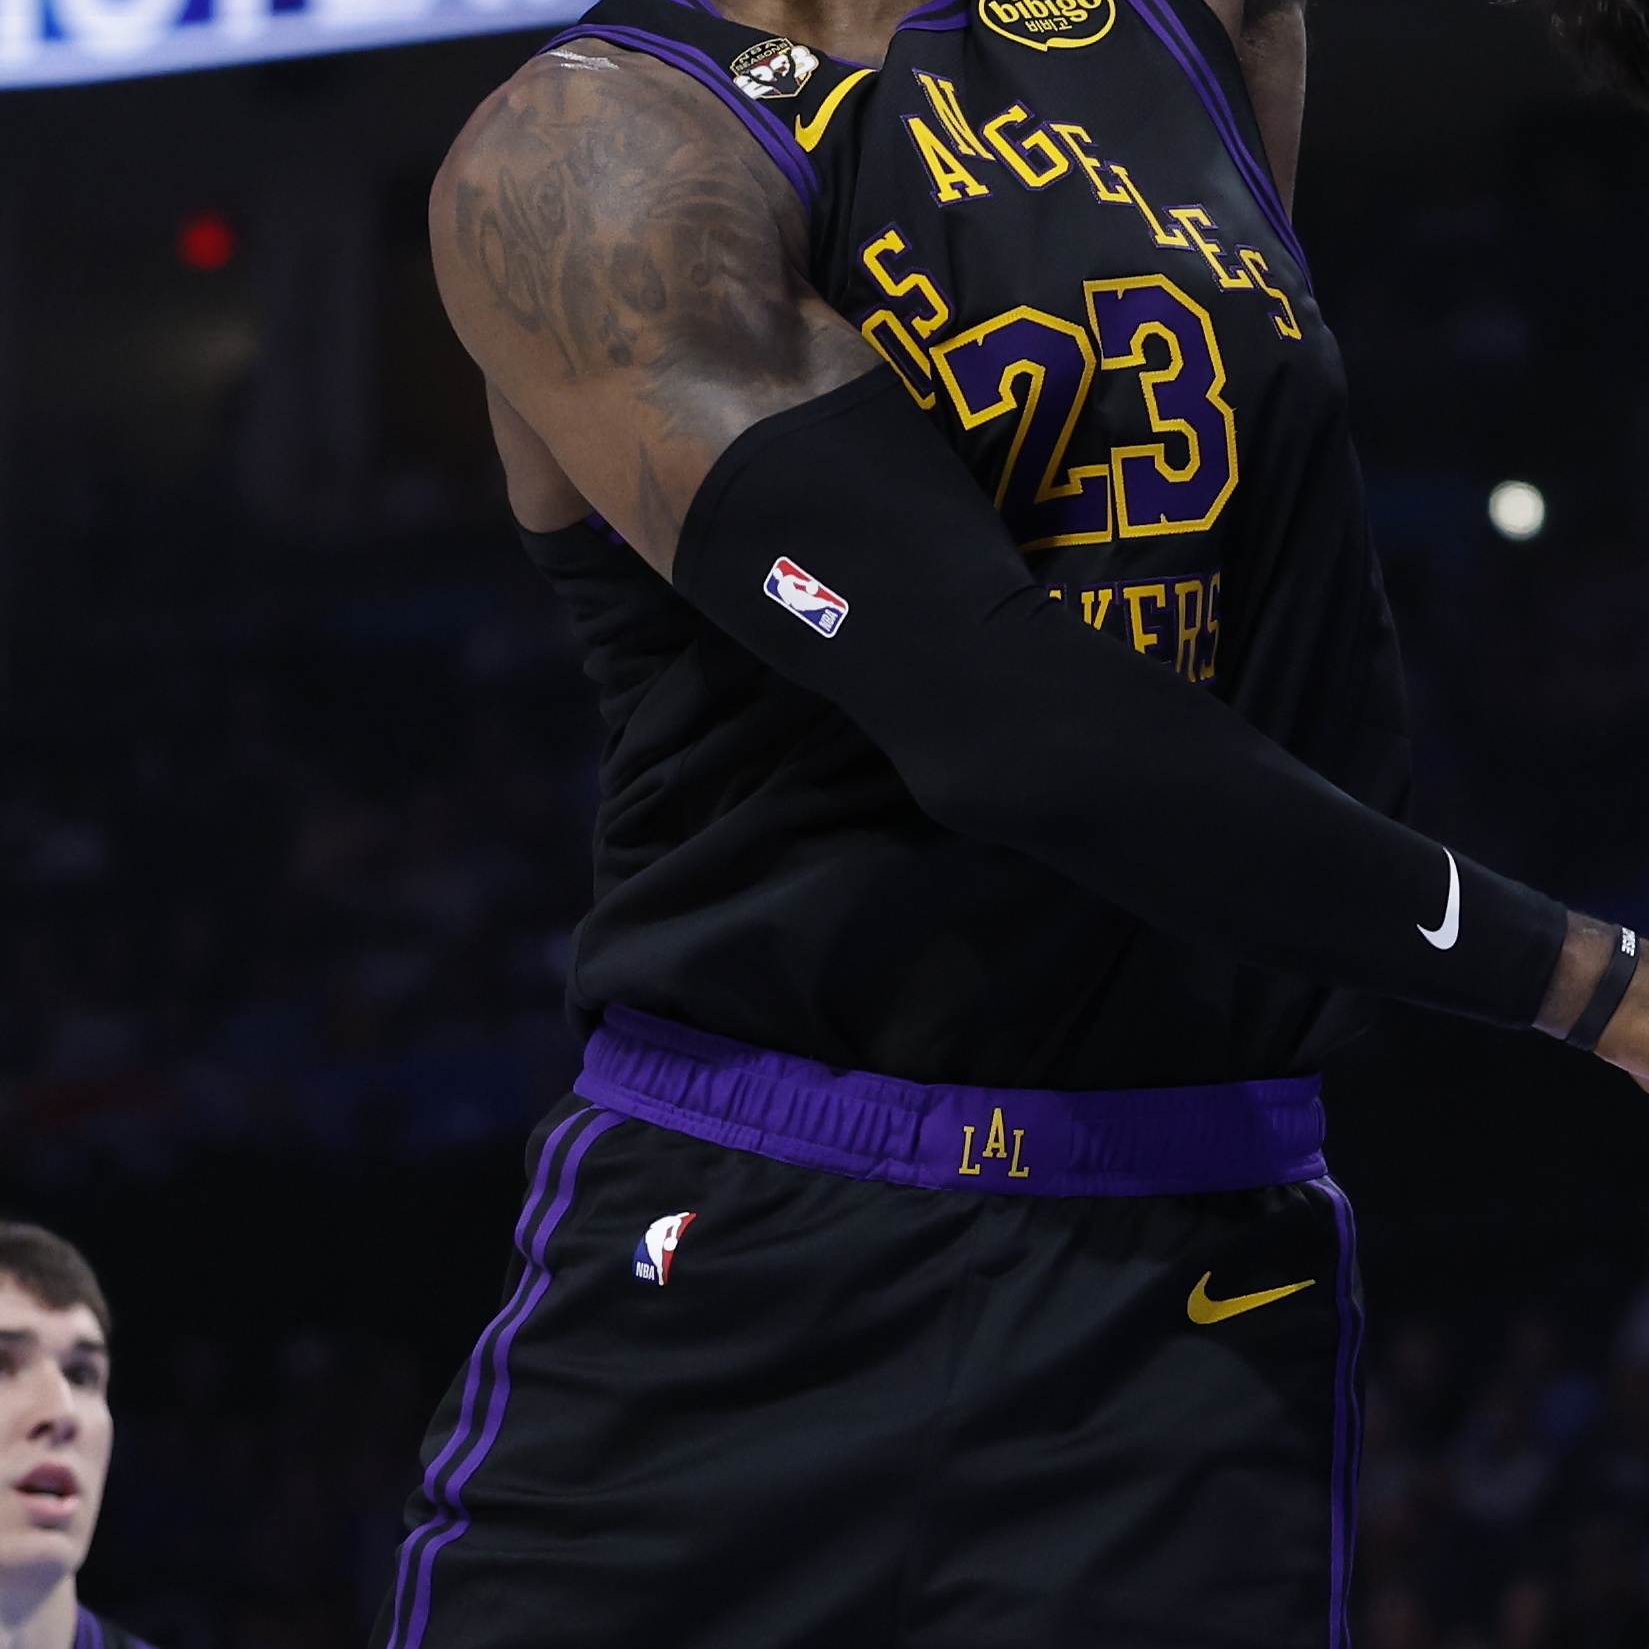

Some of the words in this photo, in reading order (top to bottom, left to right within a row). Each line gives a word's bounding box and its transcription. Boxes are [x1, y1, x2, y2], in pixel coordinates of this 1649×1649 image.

[1024, 17, 1073, 33] 비비고
[903, 69, 1302, 341] ANGELES
[928, 273, 1238, 549] 23
[956, 1106, 1031, 1180] LAL
[635, 1261, 655, 1281] NBA
